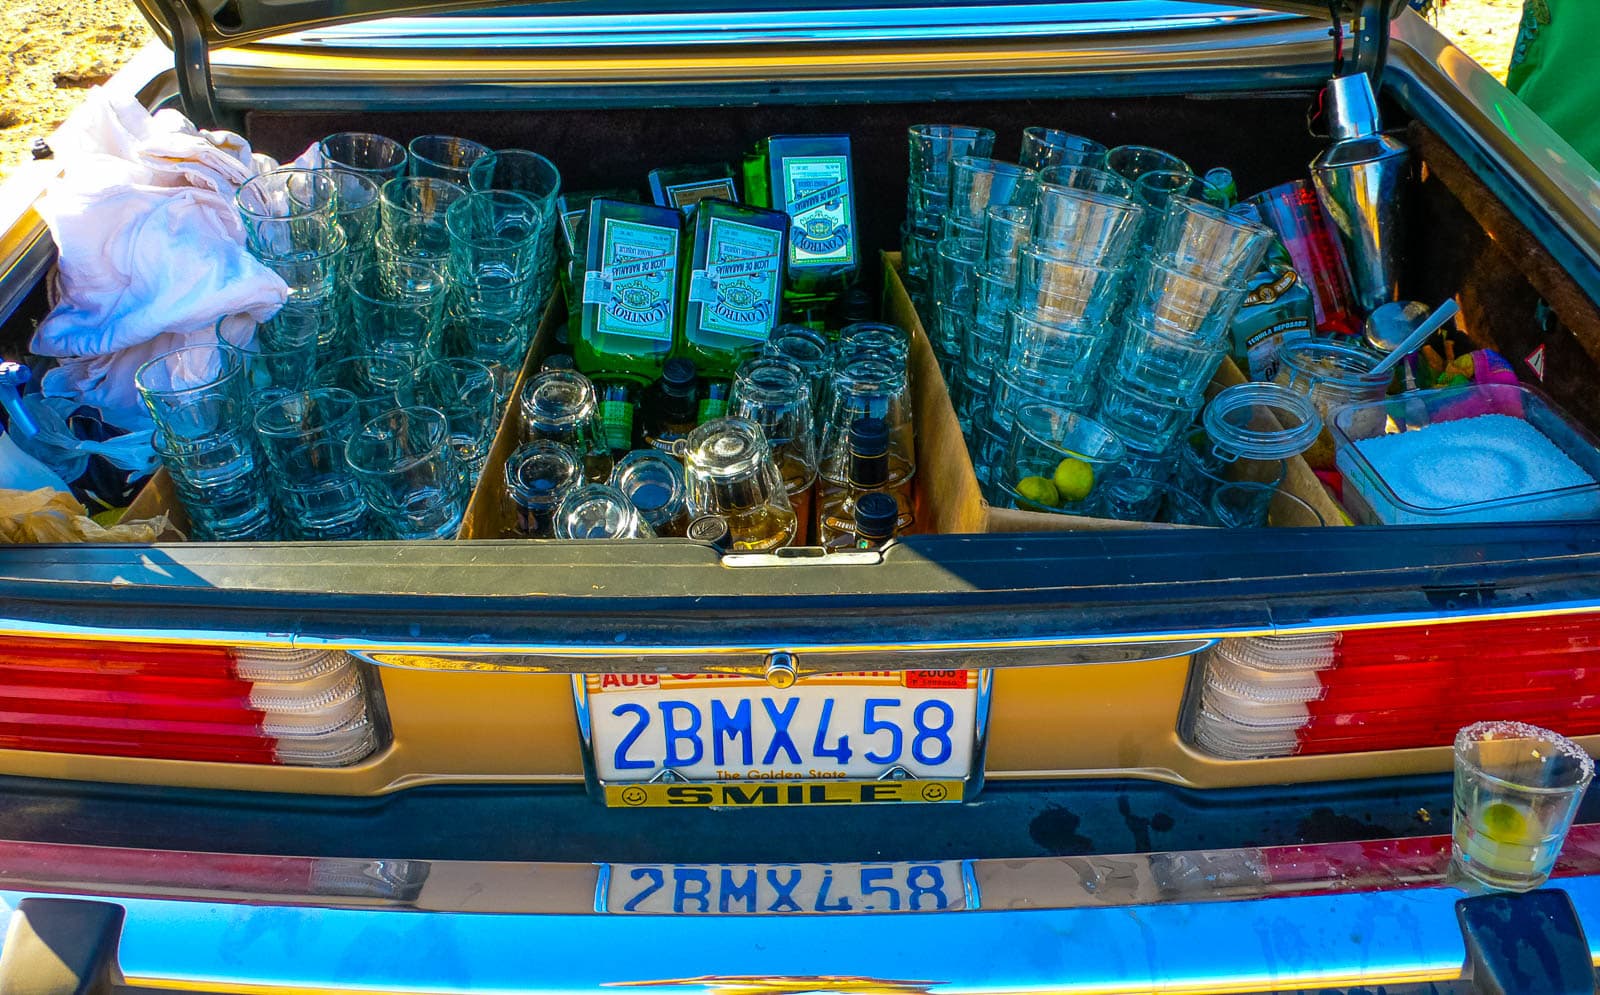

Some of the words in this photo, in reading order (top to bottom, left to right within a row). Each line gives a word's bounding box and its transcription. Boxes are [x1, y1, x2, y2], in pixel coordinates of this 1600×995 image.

[799, 235, 844, 253] CONTROY
[640, 262, 650, 272] DE
[650, 258, 666, 271] LICOR
[744, 262, 753, 272] DE
[753, 259, 769, 271] LICOR
[610, 303, 664, 324] CONTROY
[713, 302, 765, 323] CONTROY
[1248, 331, 1273, 346] TEQUILA
[602, 673, 659, 688] AUG
[612, 697, 954, 770] 2BMX458
[716, 769, 741, 779] The
[747, 769, 803, 779] Golden
[808, 768, 847, 779] State
[666, 783, 903, 805] SMILE
